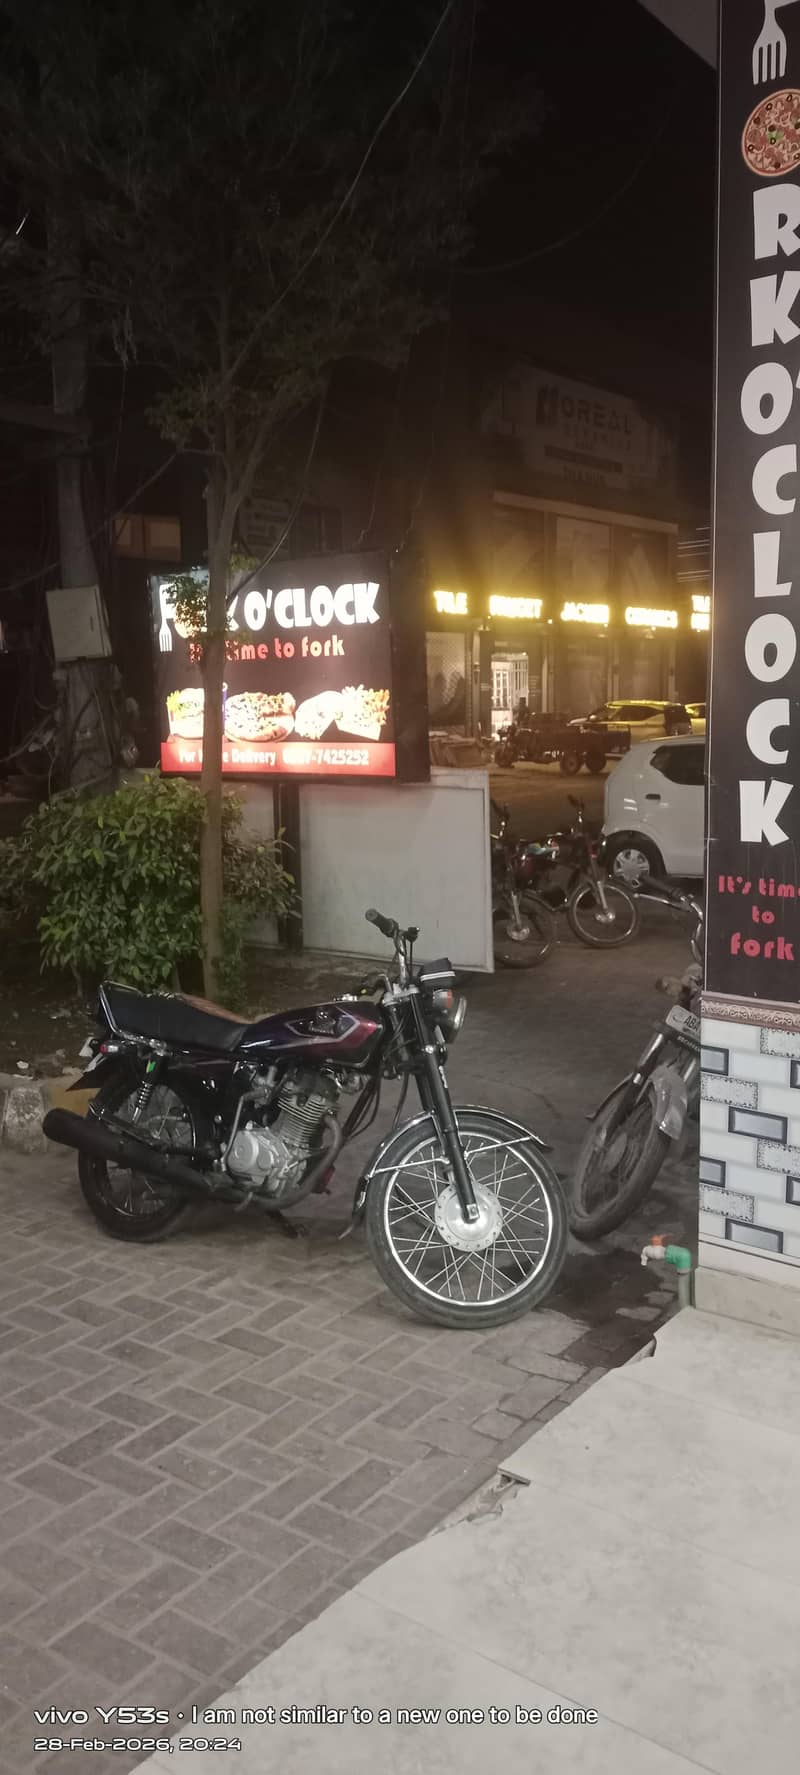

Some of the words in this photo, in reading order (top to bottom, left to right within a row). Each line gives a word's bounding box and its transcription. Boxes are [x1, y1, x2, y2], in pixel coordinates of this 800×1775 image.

[244, 582, 381, 631] O'CLOCK
[274, 638, 294, 658] to
[301, 635, 345, 657] fork
[232, 749, 276, 766] Delivery
[718, 875, 752, 894] It's
[759, 878, 800, 897] tim
[752, 905, 775, 924] to
[730, 932, 794, 960] fork
